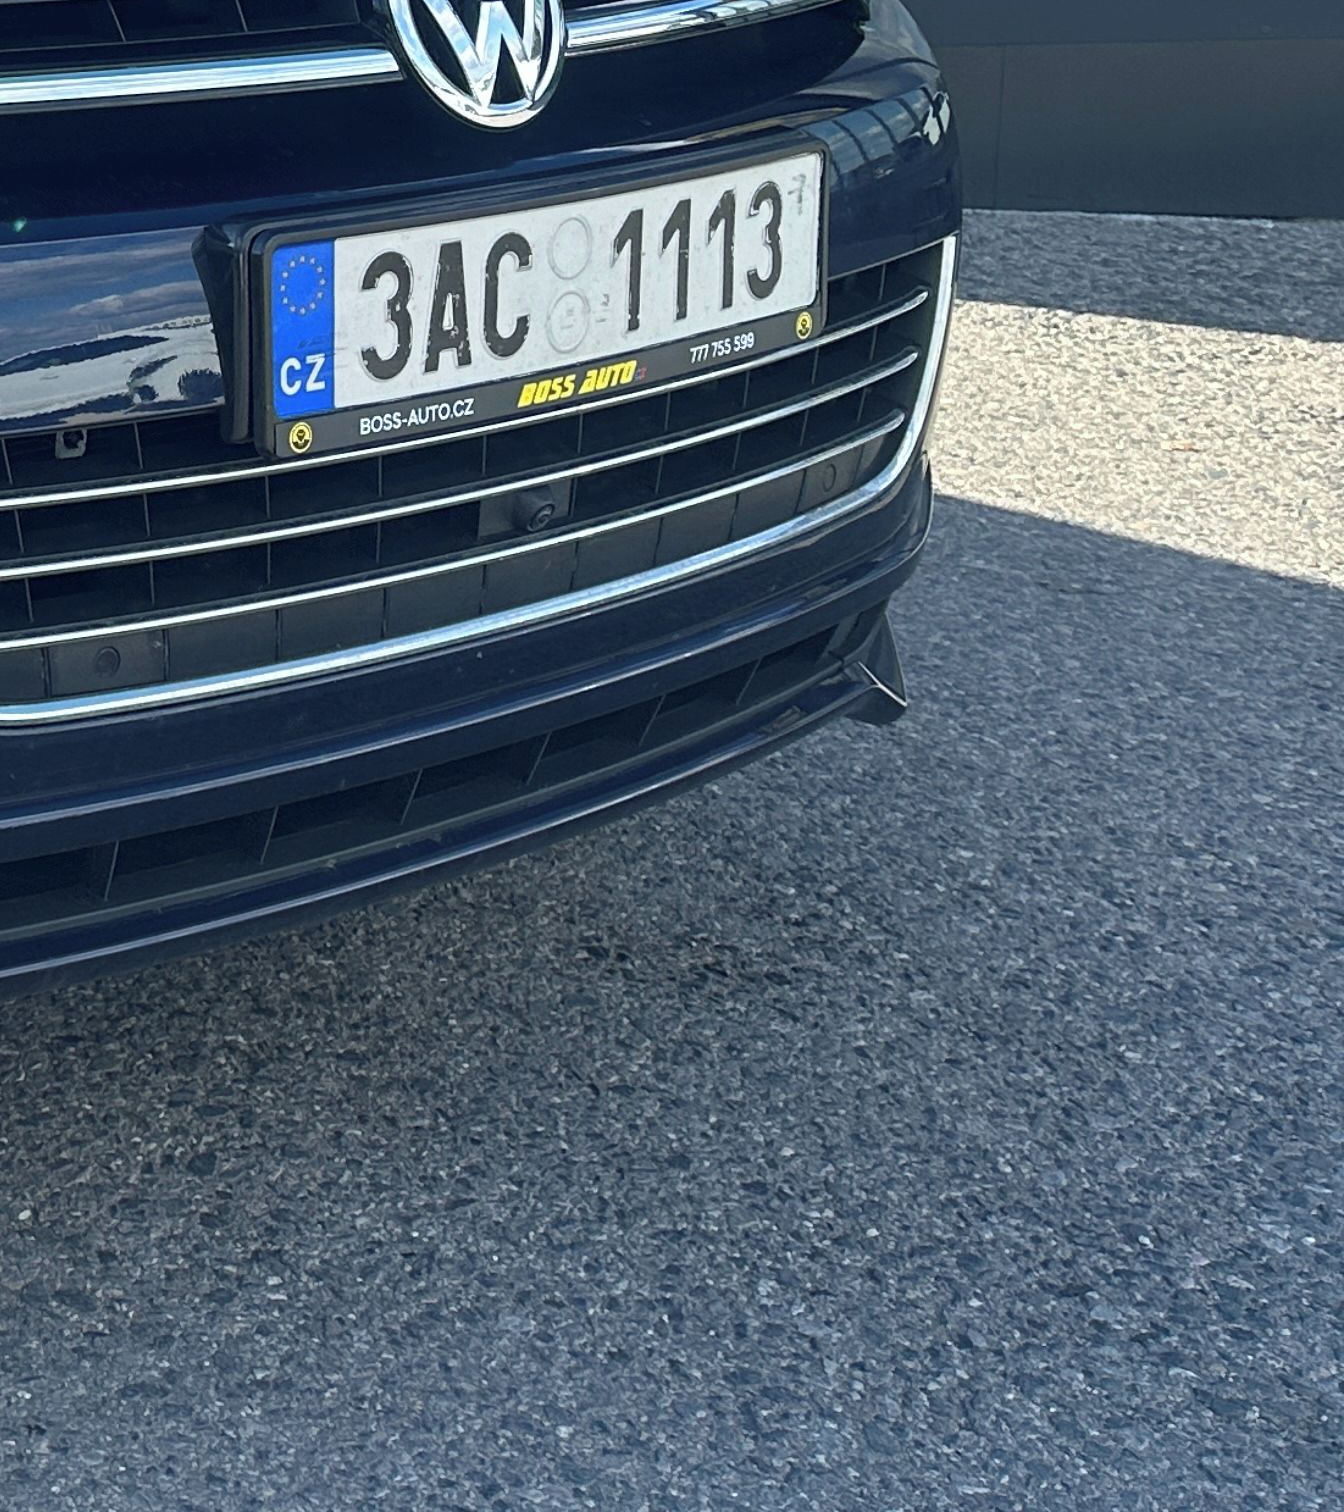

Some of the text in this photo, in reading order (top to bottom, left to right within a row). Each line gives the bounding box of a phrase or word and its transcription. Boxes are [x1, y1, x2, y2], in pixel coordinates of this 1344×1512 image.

[360, 180, 782, 380] 3AC 1113
[689, 332, 756, 364] 777 755 599
[279, 352, 326, 396] CZ
[517, 360, 638, 409] BOSS AUTO
[359, 397, 475, 436] BOSS-AUTO.CZ
